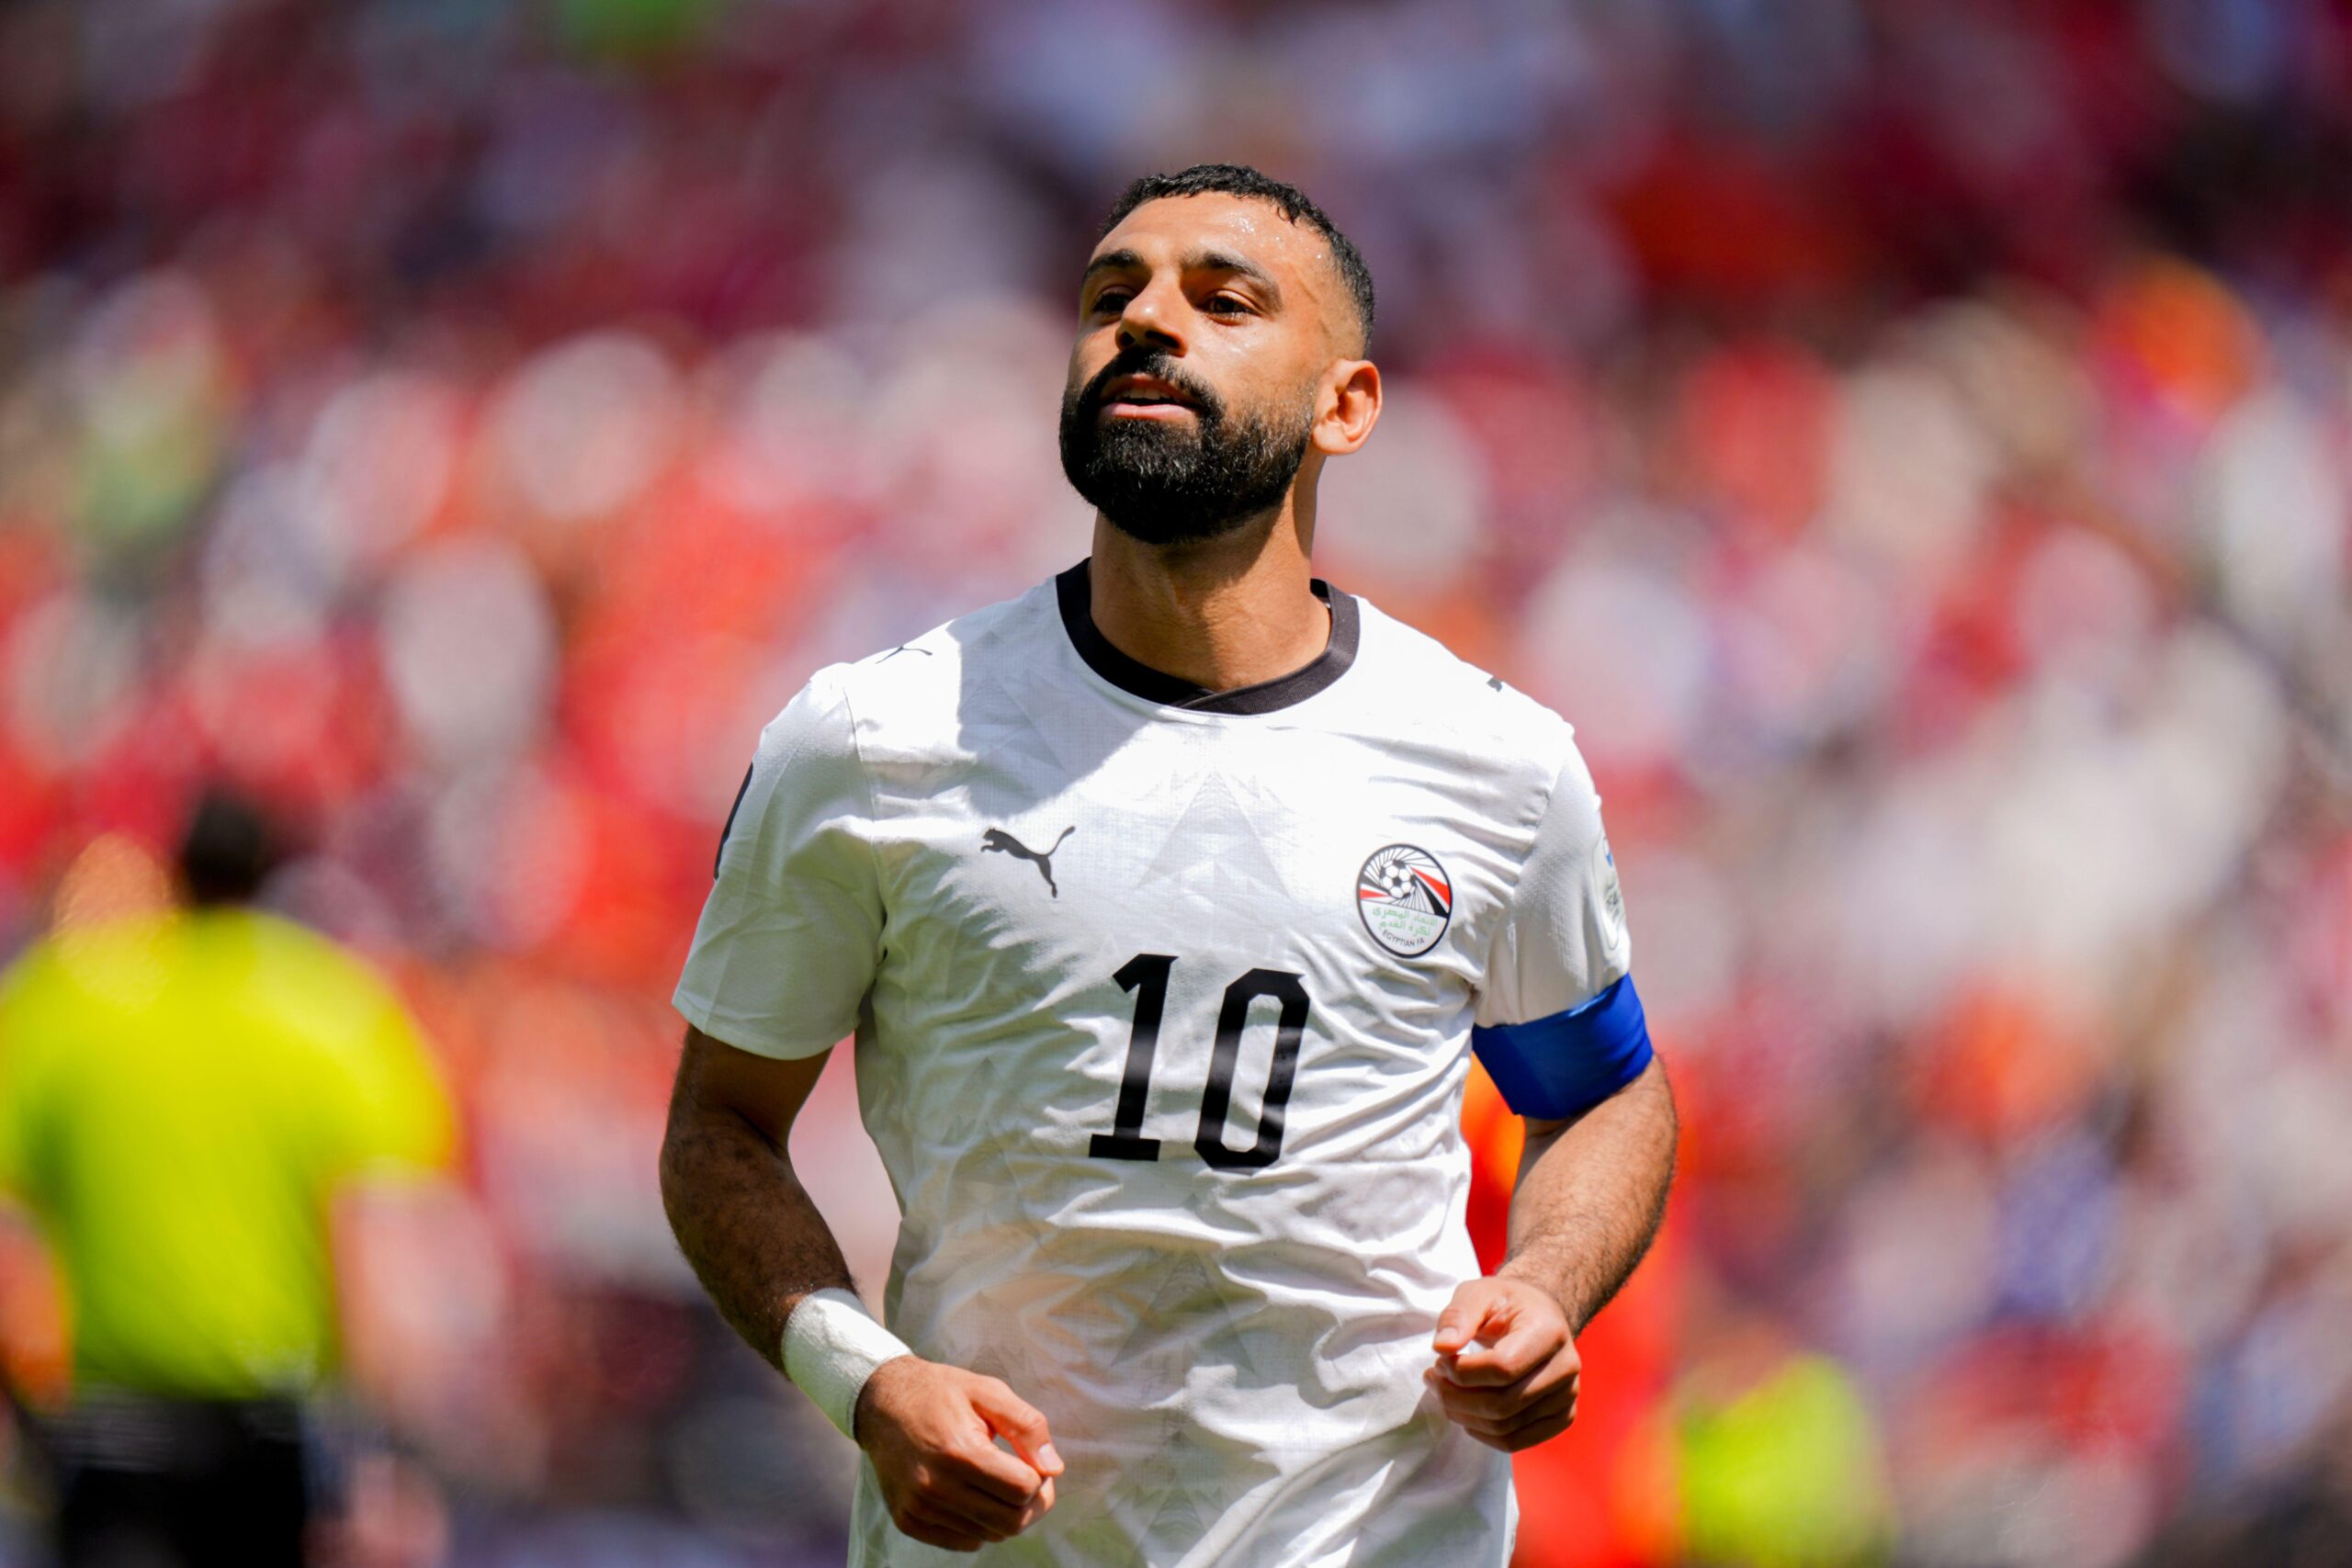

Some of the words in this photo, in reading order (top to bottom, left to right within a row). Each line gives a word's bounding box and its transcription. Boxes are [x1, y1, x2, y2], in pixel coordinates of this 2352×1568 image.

[1382, 929, 1415, 947] EGYPTIAN
[1417, 937, 1425, 947] FA
[1089, 953, 1310, 1177] 10
